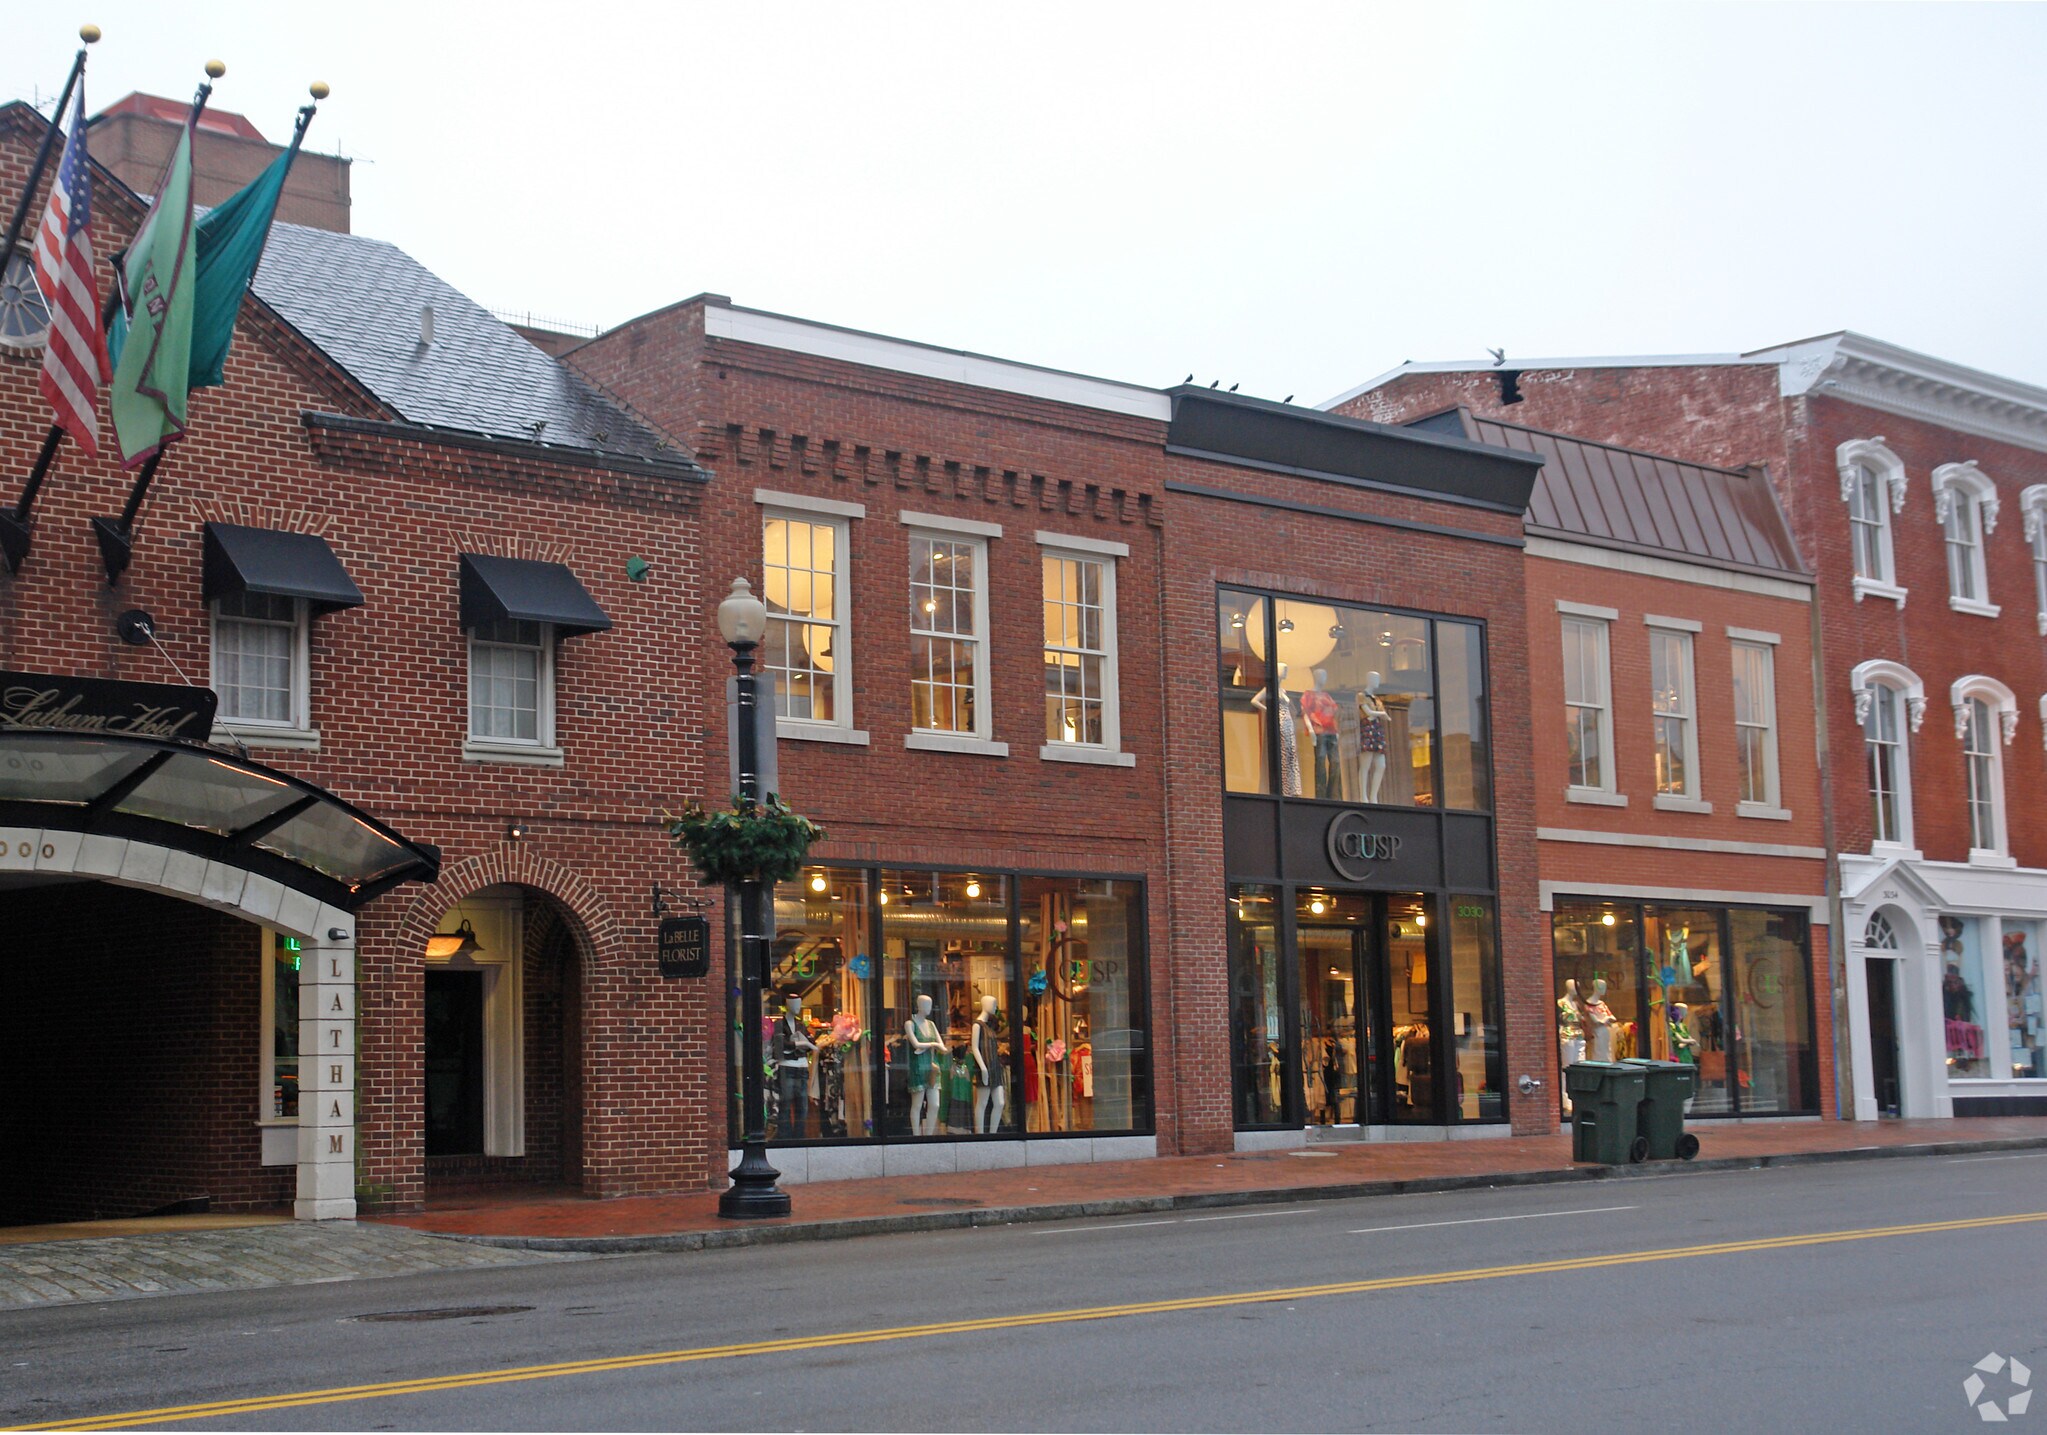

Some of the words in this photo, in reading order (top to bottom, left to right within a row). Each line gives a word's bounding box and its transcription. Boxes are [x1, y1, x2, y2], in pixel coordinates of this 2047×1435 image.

[0, 686, 106, 728] Latham
[106, 702, 198, 738] Hotel
[662, 947, 702, 962] FLORIST
[329, 958, 344, 1154] LATHAM
